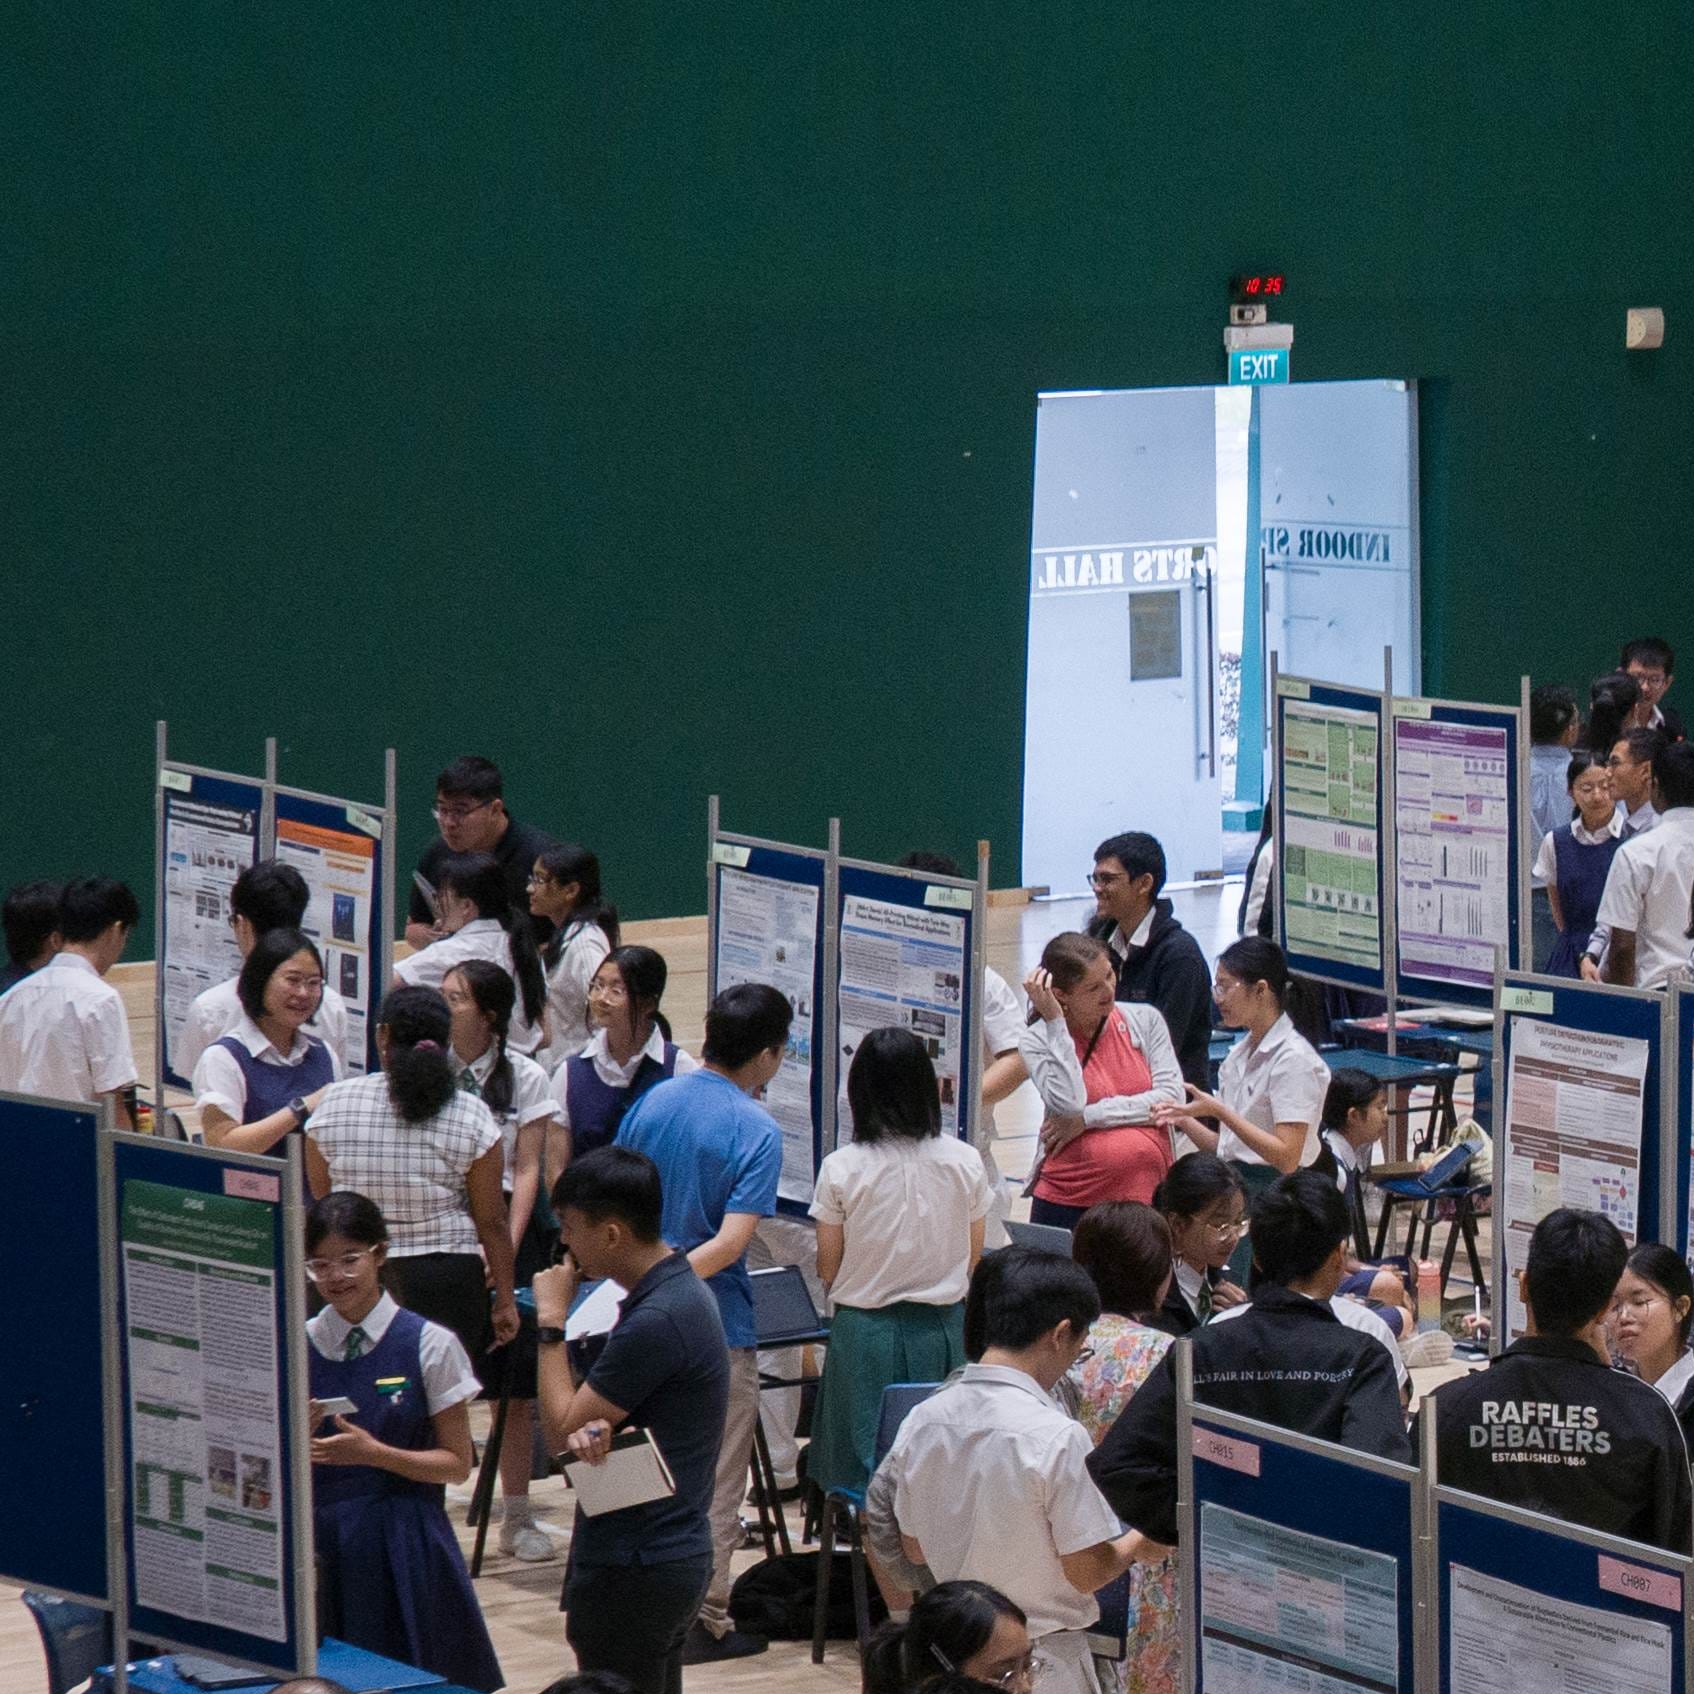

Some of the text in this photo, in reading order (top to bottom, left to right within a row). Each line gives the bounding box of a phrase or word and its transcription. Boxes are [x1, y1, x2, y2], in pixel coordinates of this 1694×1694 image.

[1240, 354, 1278, 380] EXIT
[1213, 1371, 1238, 1382] FAIR
[1241, 1371, 1254, 1381] IN
[1257, 1371, 1283, 1380] LOVE
[1286, 1371, 1311, 1381] AND
[1482, 1401, 1599, 1430] RAFFLES
[1469, 1425, 1612, 1454] DEBATERS
[1492, 1452, 1560, 1464] ESTABLISHED
[1620, 1572, 1650, 1593] CH007
